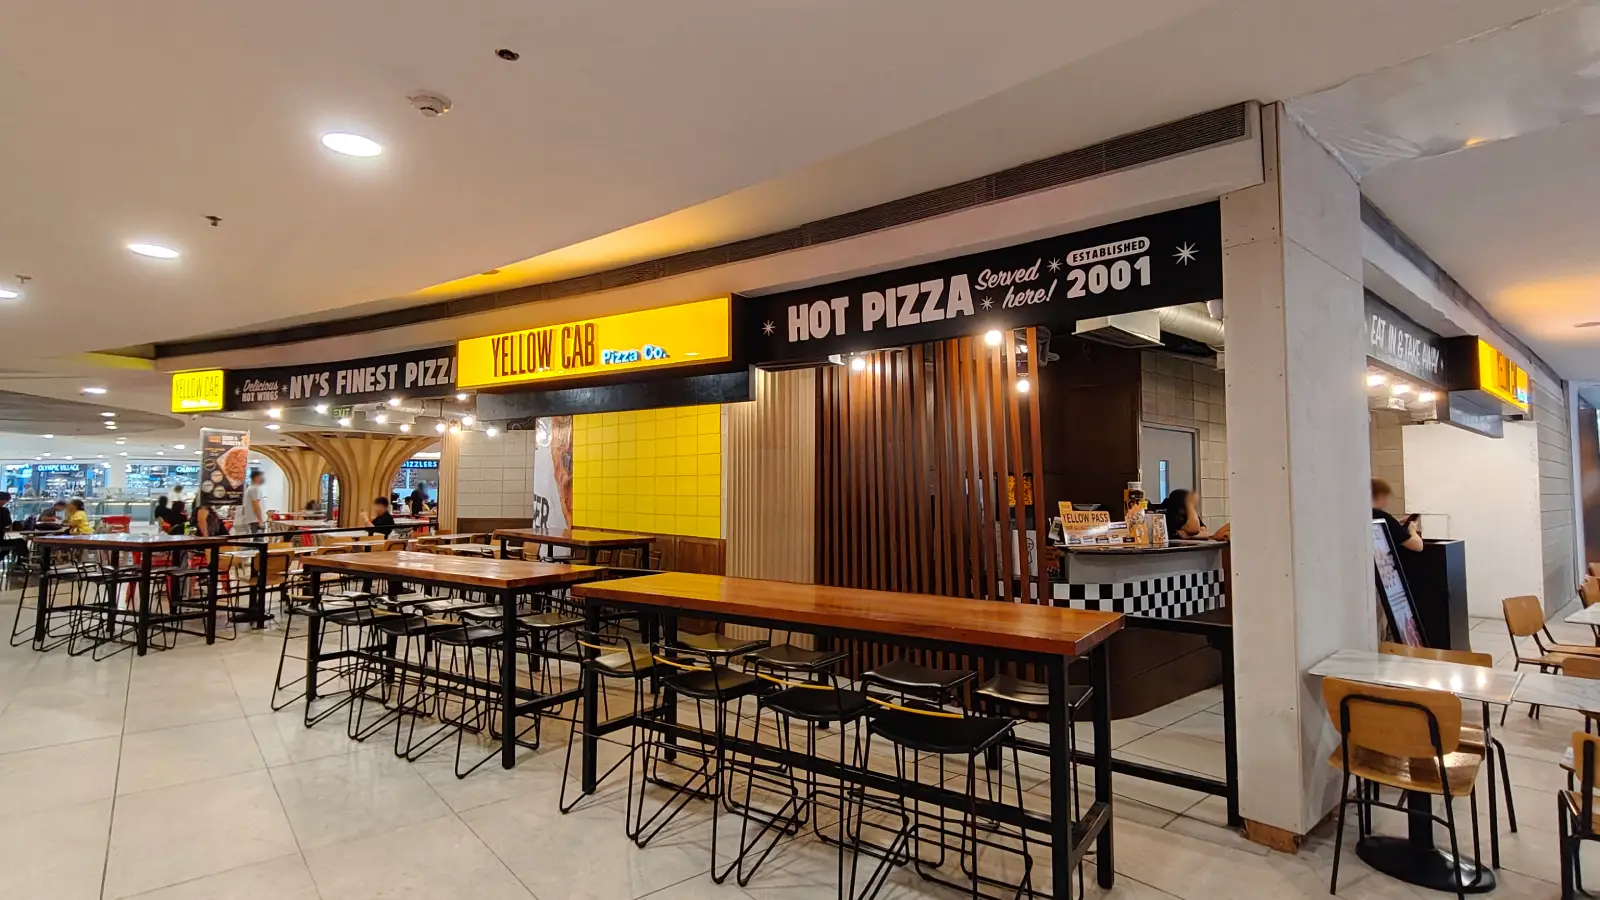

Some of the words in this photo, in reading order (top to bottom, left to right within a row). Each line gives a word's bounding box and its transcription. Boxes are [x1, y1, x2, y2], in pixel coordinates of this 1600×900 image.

[1072, 240, 1146, 263] ESTABLISHED
[974, 258, 1041, 291] Served
[1066, 256, 1151, 299] 2001
[788, 296, 850, 343] HOT
[862, 273, 975, 332] PIZZA
[1002, 279, 1057, 309] here!
[491, 329, 553, 378] YELLOW
[561, 323, 595, 369] CAB
[602, 348, 639, 365] Pizza
[643, 344, 669, 360] Co.
[1371, 314, 1387, 349] EAT
[1388, 323, 1397, 356] IN
[1404, 332, 1421, 365] TAKE
[1421, 342, 1440, 374] AWAY
[175, 378, 202, 398] YELLOW
[204, 376, 219, 397] CAB
[242, 392, 255, 402] HOT
[257, 391, 278, 401] WINGS
[243, 379, 279, 392] Delicious
[289, 372, 330, 400] NY'S
[336, 364, 398, 395] FINEST
[333, 408, 350, 418] EXIT
[1062, 513, 1089, 523] YELLOW
[1091, 513, 1109, 522] PASS
